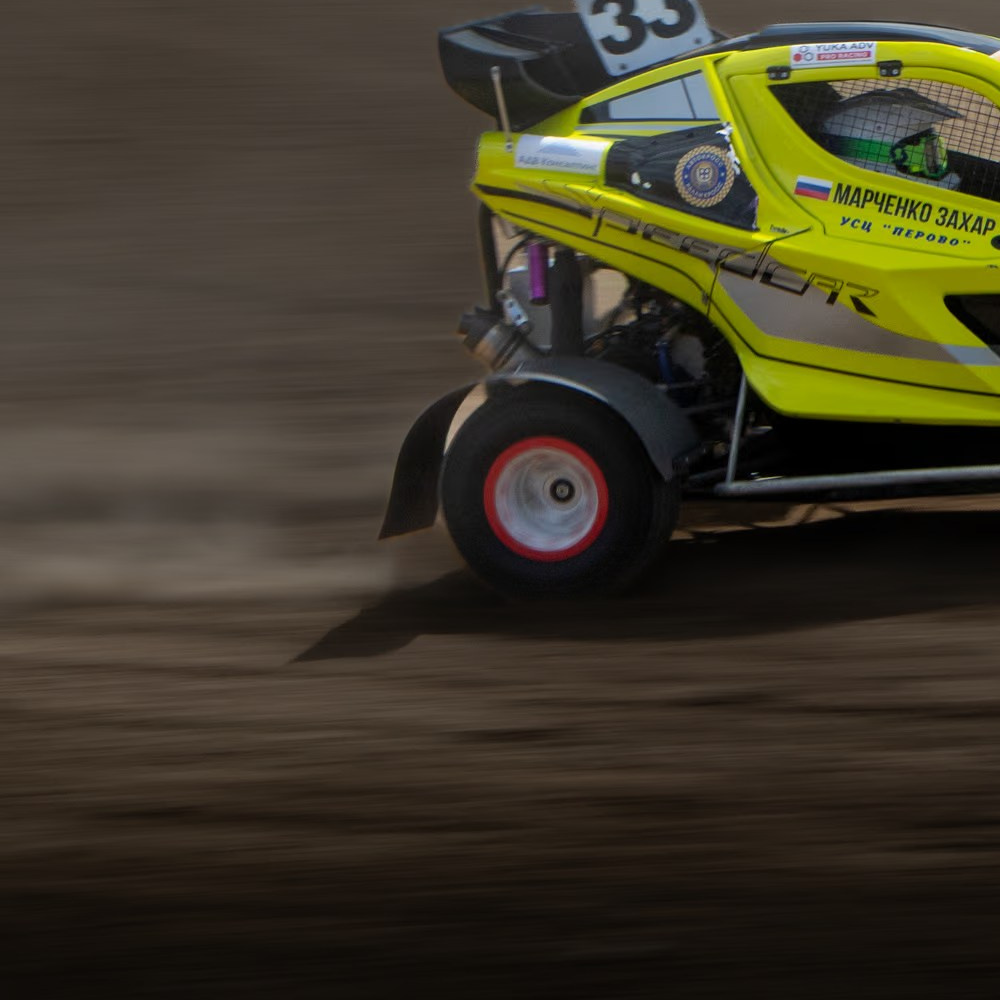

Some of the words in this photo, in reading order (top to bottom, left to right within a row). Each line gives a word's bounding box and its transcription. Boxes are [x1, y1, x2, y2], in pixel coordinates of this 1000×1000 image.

[816, 43, 848, 52] YUKA
[849, 42, 874, 50] ADV
[819, 53, 837, 61] PRO
[838, 51, 868, 60] RACING
[832, 182, 933, 223] МАРЧЕНКО
[935, 206, 997, 236] ЗАХАР
[839, 216, 873, 233] УСЦ
[882, 223, 972, 247] "ПЕРОВО"
